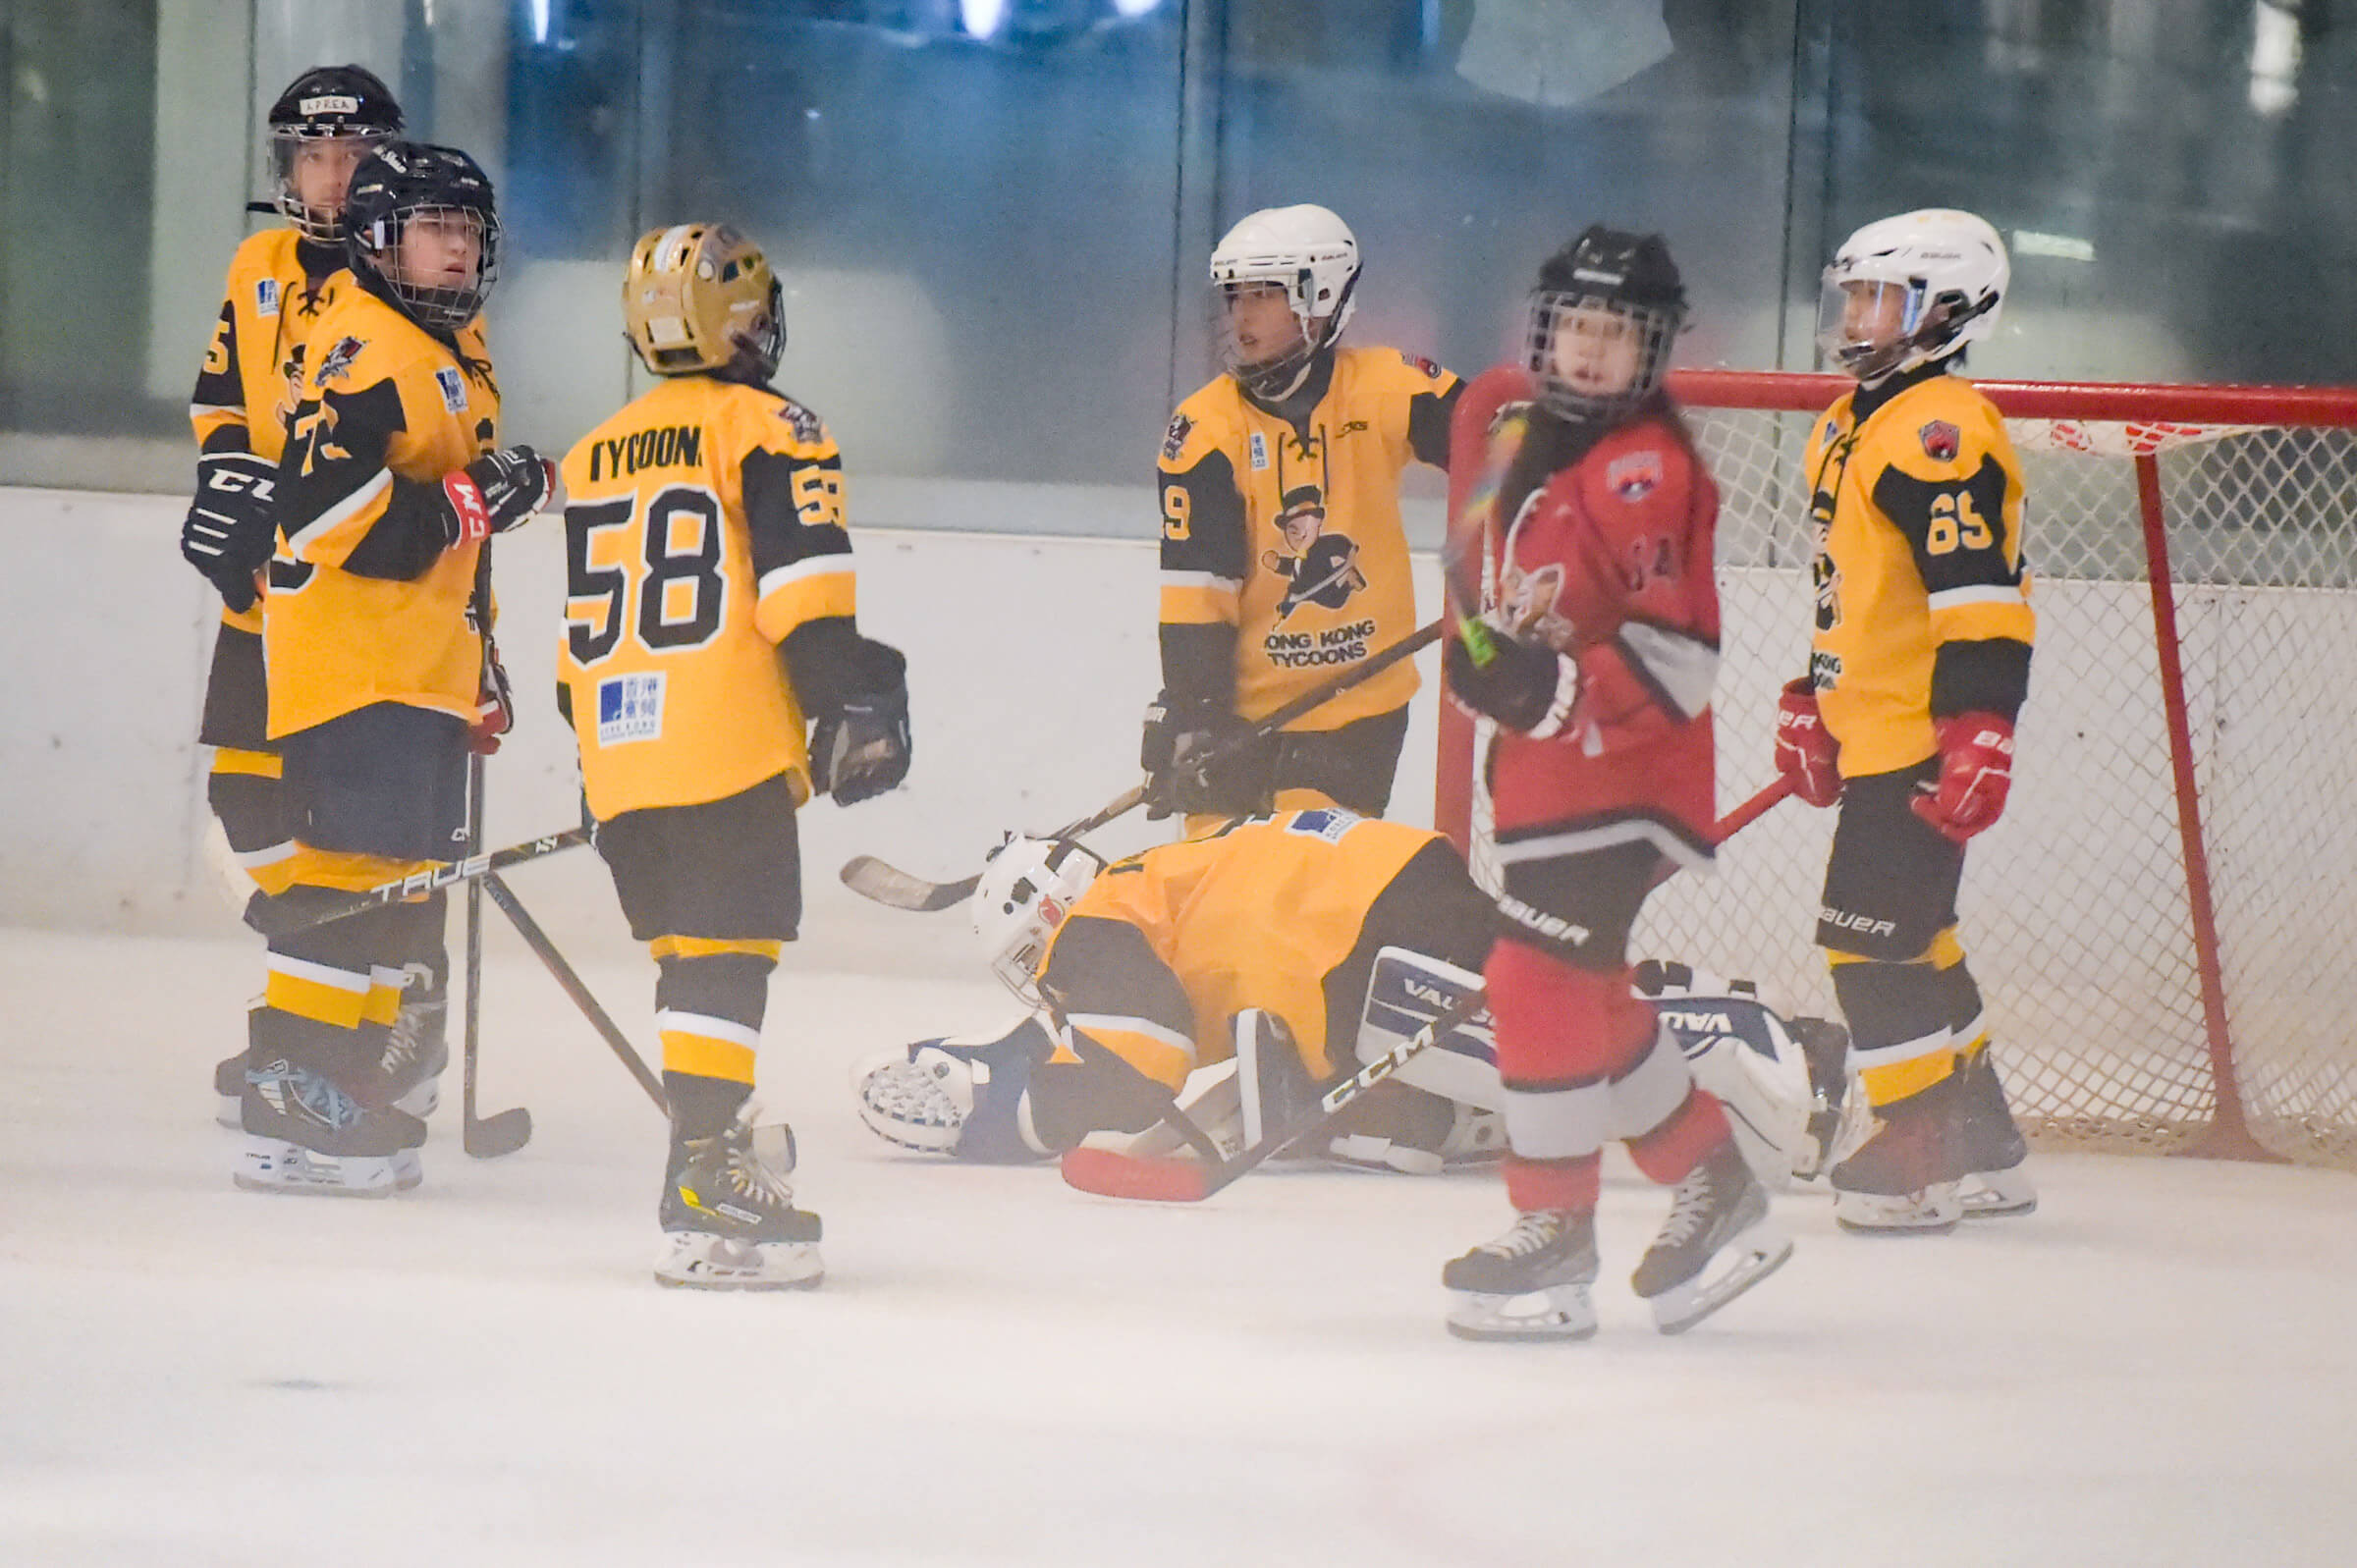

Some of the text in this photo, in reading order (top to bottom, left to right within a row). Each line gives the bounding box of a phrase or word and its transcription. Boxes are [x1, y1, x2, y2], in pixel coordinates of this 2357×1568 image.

[1927, 490, 1994, 556] 65
[564, 486, 729, 671] 58
[1264, 619, 1375, 650] ONG KONG
[1267, 641, 1368, 668] TYCOONS
[370, 854, 491, 902] TRUE
[1322, 1023, 1435, 1114] CCM
